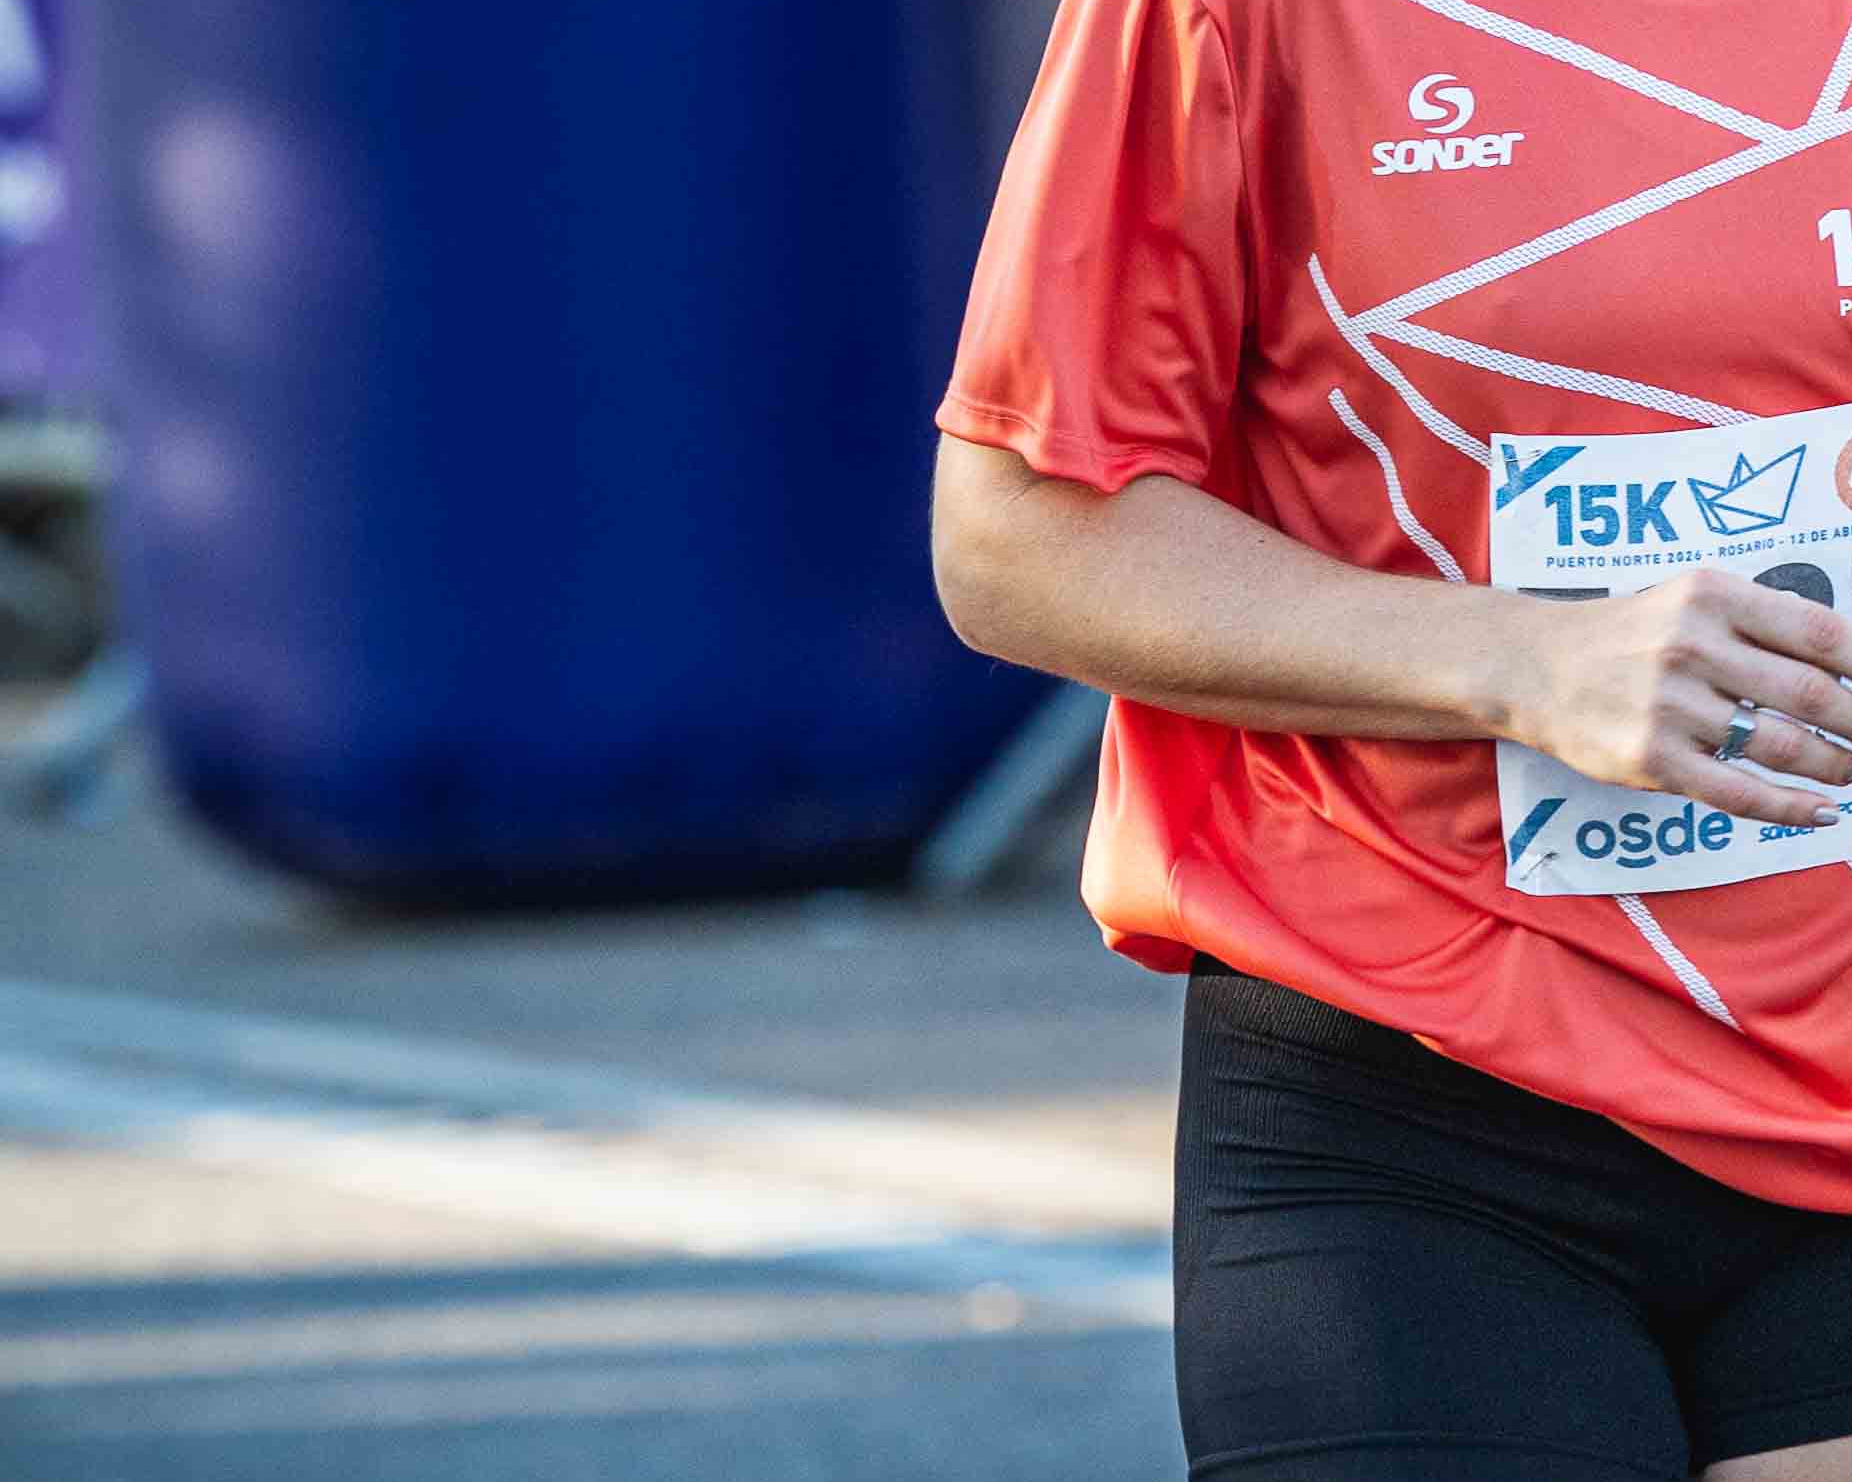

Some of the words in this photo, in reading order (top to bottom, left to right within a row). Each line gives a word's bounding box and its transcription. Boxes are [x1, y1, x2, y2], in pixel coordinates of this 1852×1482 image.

[1544, 479, 1679, 547] 15K
[1546, 555, 1607, 568] PUERTO
[1611, 553, 1662, 567] NORTE
[1666, 549, 1702, 564] 2026
[1717, 537, 1775, 558] ROSARIO
[1790, 532, 1806, 545] 12
[1811, 528, 1829, 542] DE
[1575, 801, 1734, 860] osde
